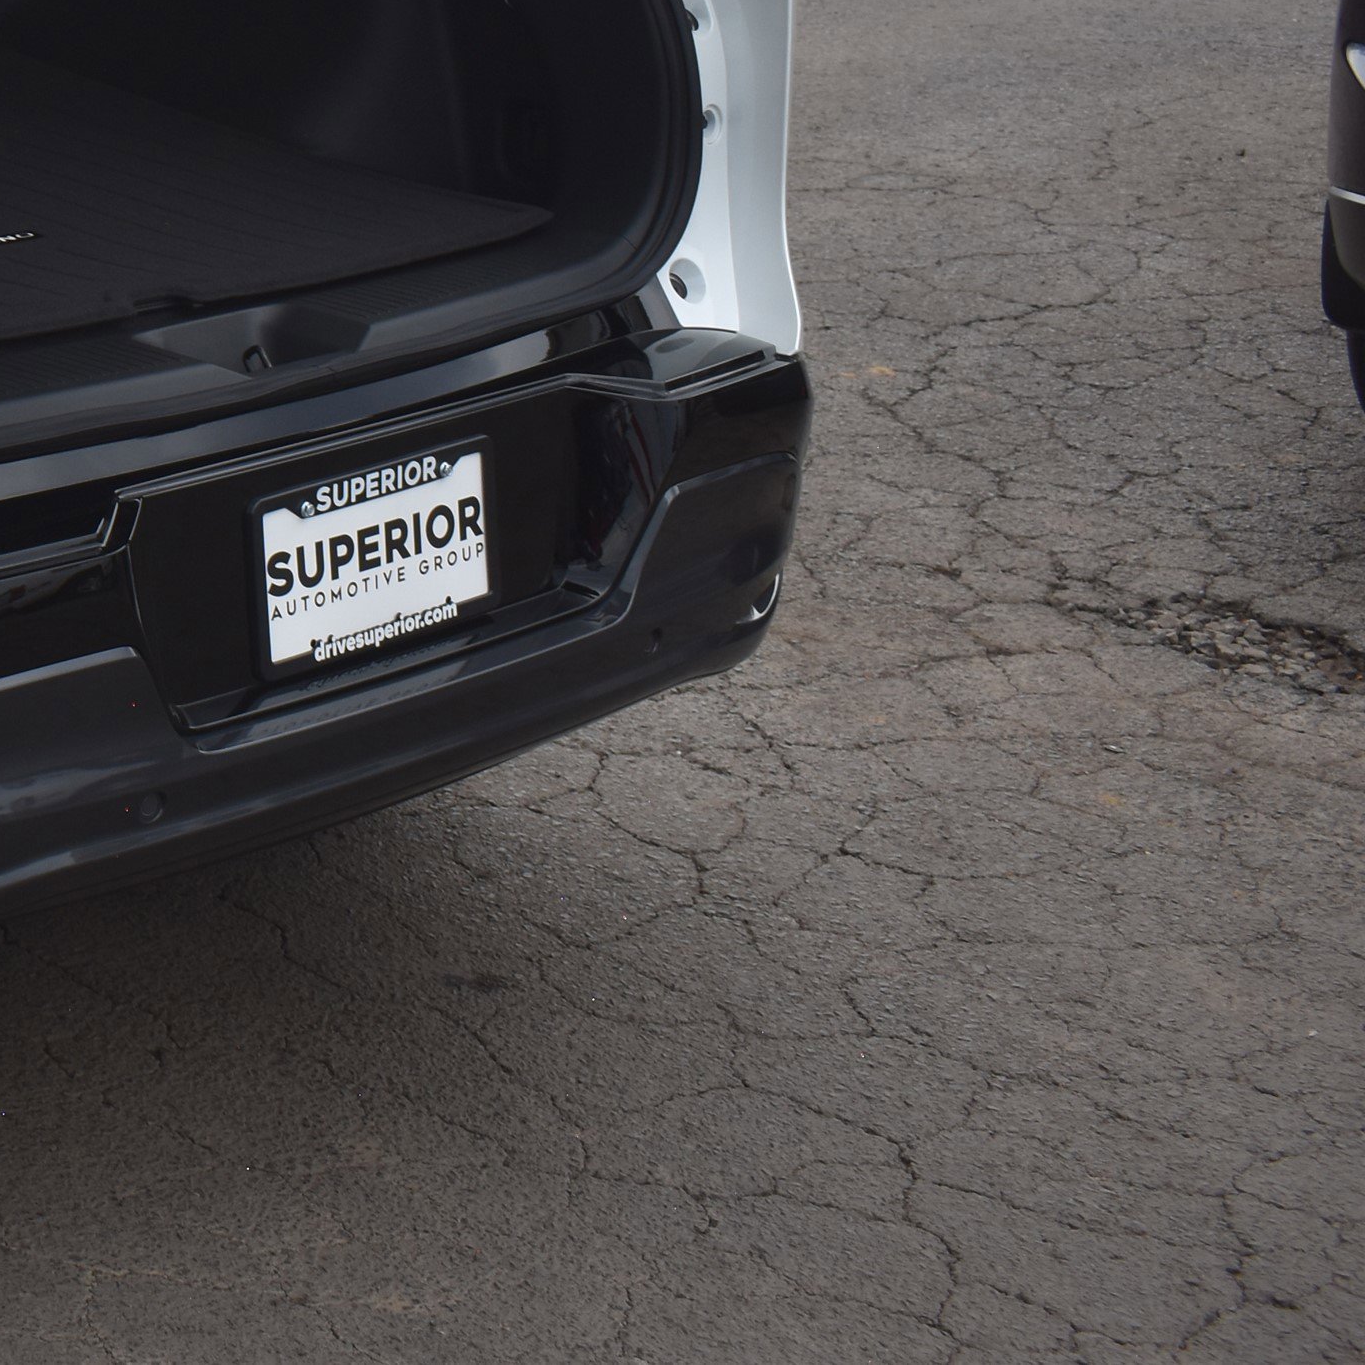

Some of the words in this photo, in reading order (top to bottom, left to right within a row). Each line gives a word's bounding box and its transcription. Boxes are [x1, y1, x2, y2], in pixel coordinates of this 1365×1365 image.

[316, 456, 437, 512] SUPERIOR
[267, 495, 484, 597] SUPERIOR
[271, 567, 407, 621] AUTOMOTIVE
[419, 542, 484, 575] GROUP
[314, 601, 458, 662] drivesuperior.com
